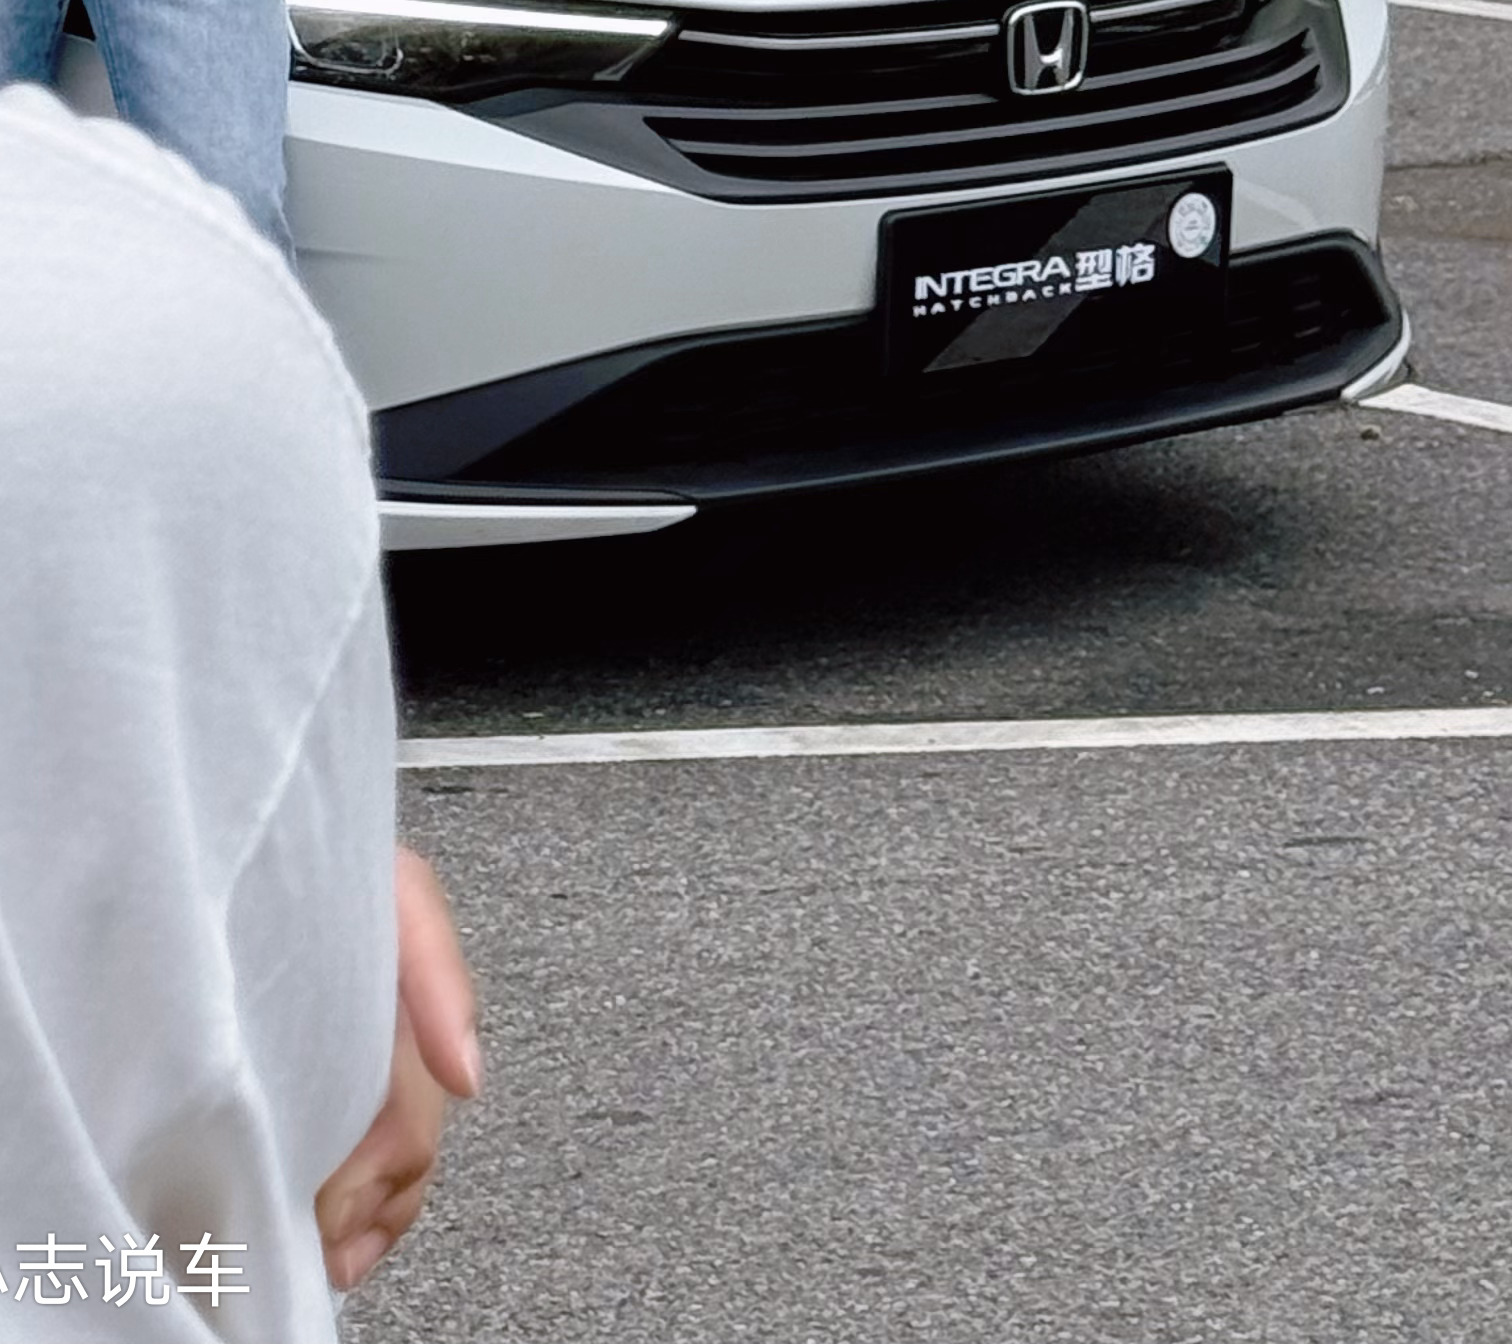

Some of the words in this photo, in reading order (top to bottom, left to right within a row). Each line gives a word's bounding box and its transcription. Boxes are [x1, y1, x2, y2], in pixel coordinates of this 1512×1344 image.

[914, 256, 1070, 300] INTEGRA
[1074, 242, 1156, 292] 型格
[913, 282, 1072, 317] HATCHBACK
